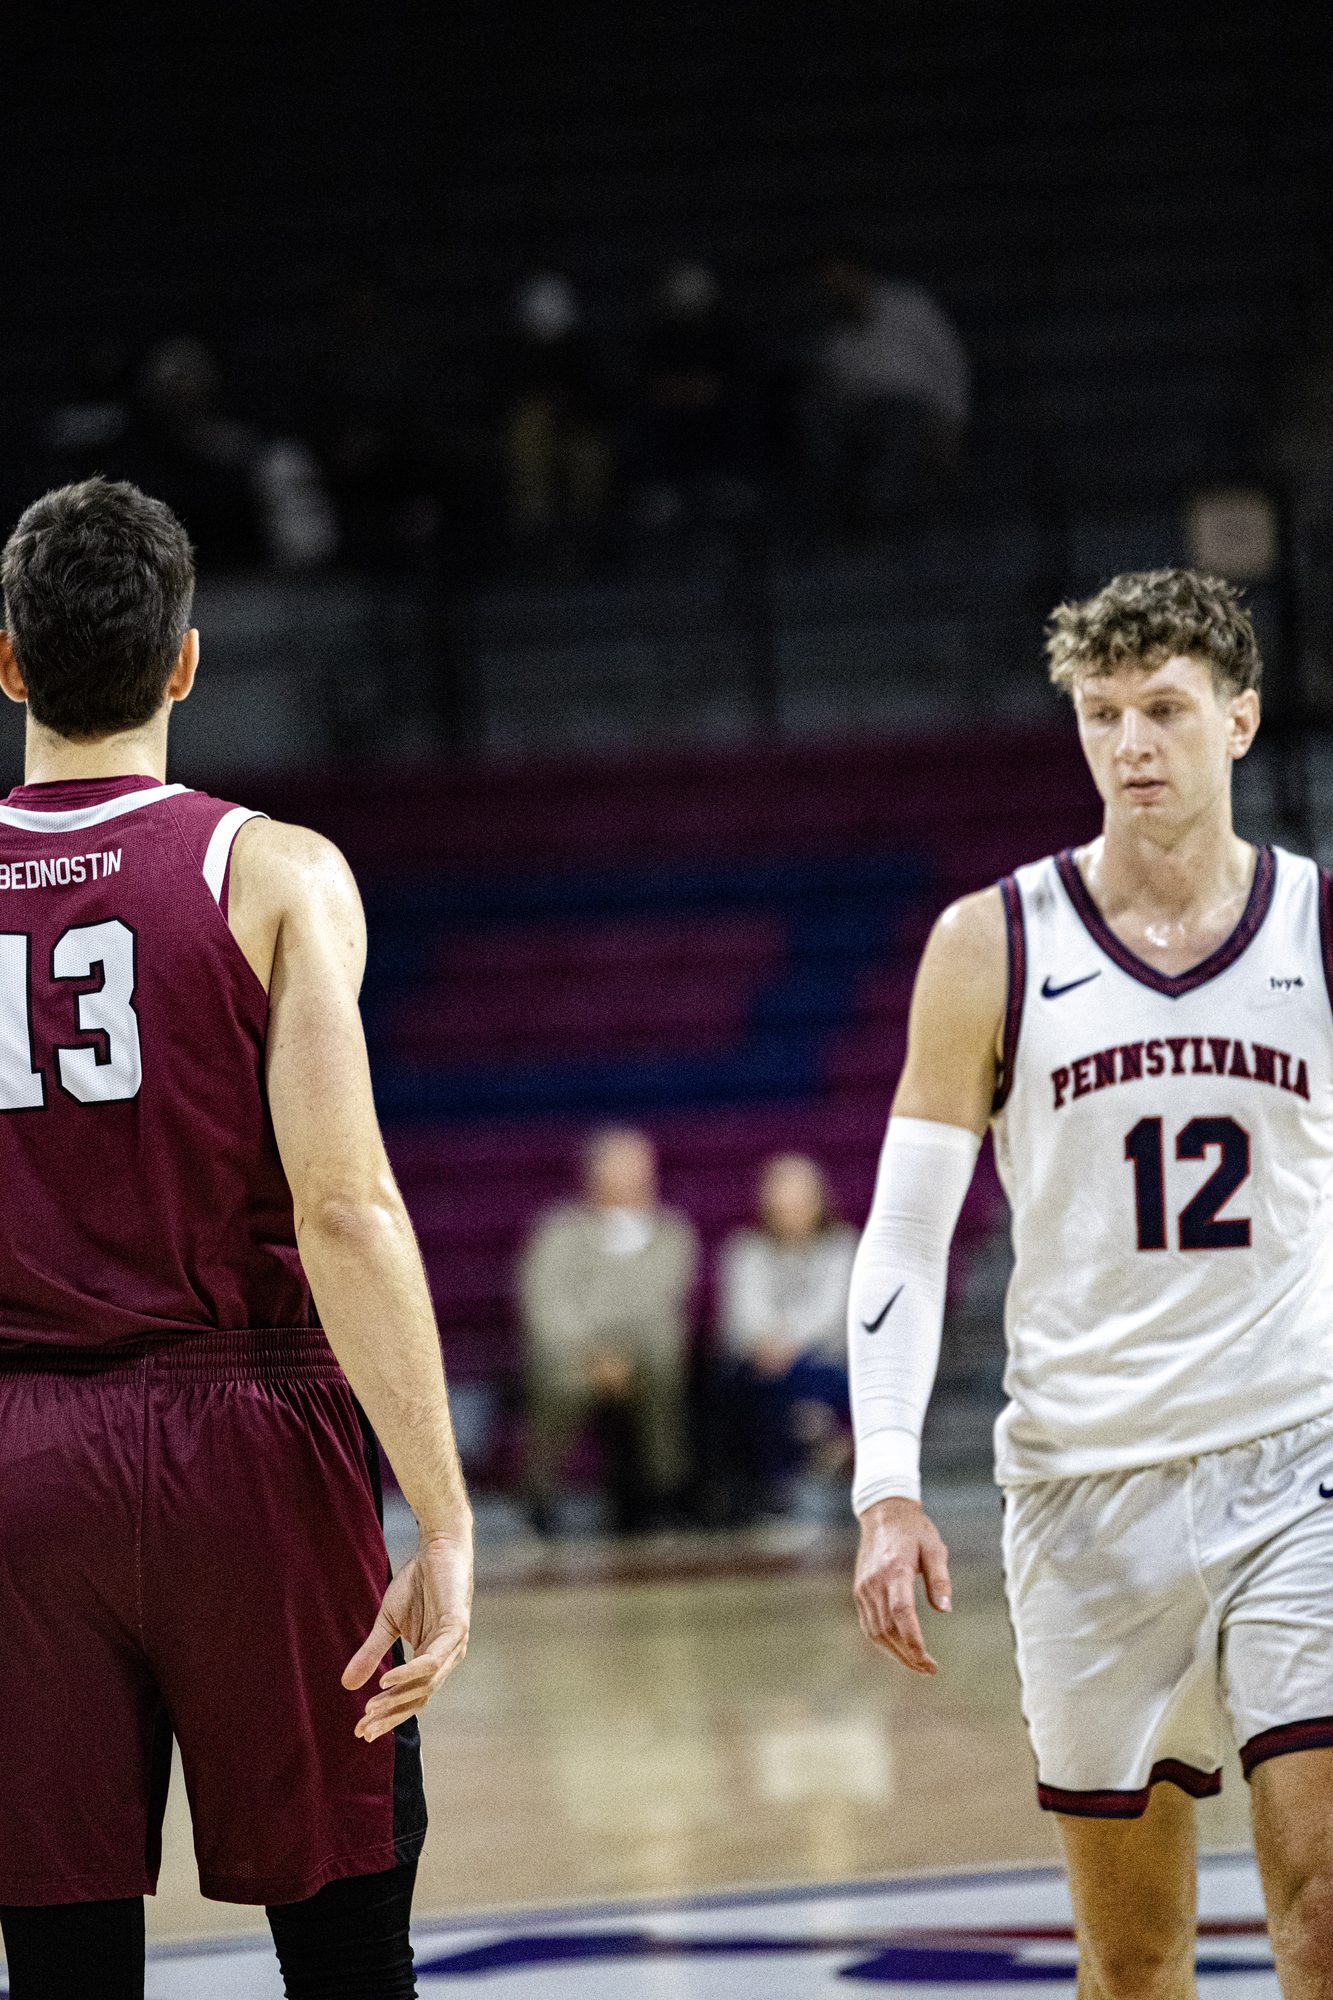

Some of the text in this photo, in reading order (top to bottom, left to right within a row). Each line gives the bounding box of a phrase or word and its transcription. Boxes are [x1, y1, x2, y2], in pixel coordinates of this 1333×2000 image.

[0, 848, 122, 889] BEDNOSTIN
[0, 919, 143, 1113] 13
[1051, 1036, 1311, 1110] PENNSYLVANIA
[1124, 1115, 1252, 1251] 12
